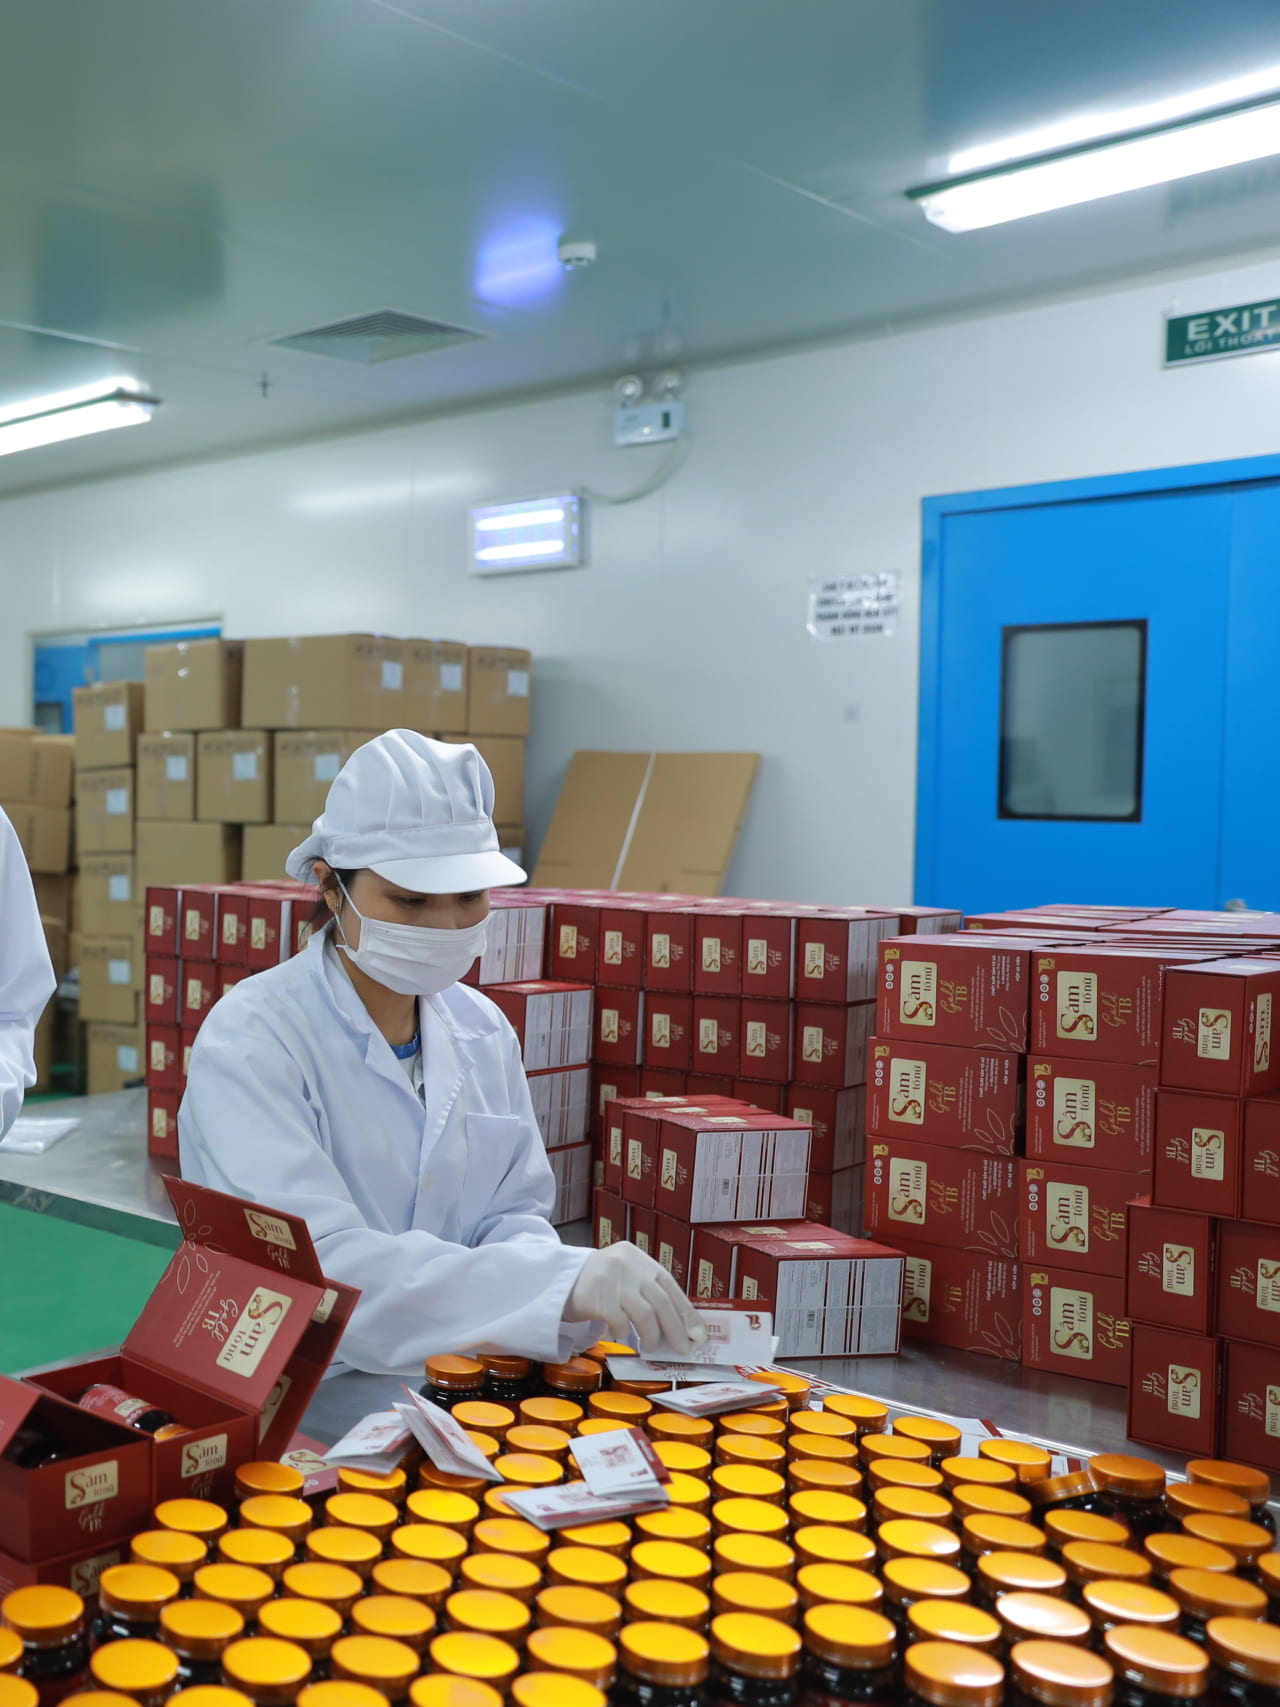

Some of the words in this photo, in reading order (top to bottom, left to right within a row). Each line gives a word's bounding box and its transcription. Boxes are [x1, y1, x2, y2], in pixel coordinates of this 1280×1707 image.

[1187, 304, 1277, 341] EXIT
[903, 974, 933, 1020] Sâm
[939, 979, 963, 1014] Gold
[955, 985, 968, 1002] TB
[1060, 985, 1094, 1034] Sâm
[1101, 992, 1126, 1027] Gold
[1119, 997, 1133, 1014] TB
[1172, 1027, 1183, 1040] TB
[1179, 1018, 1196, 1045] Gold
[1201, 1011, 1229, 1049] Sâm
[892, 1072, 921, 1119] Sâm
[929, 1080, 950, 1114] Gold
[944, 1086, 956, 1102] TB
[1057, 1092, 1092, 1142] Sâm
[1099, 1100, 1124, 1135] Gold
[1117, 1106, 1131, 1123] TB
[1166, 1146, 1176, 1159] TB
[1194, 1132, 1222, 1169] Sâm
[891, 1172, 923, 1219] Sâm
[929, 1179, 952, 1214] Gold
[946, 1187, 959, 1203] TB
[1050, 1197, 1086, 1248] Sâm
[1092, 1204, 1119, 1241] Gold
[1111, 1212, 1125, 1229] TB
[1138, 1259, 1149, 1272] TB
[1165, 1247, 1192, 1285] Sâm
[1230, 1274, 1242, 1288] TB
[1053, 1302, 1090, 1354] Sâm
[1097, 1312, 1124, 1349] Gold
[1115, 1320, 1130, 1337] TB
[1142, 1379, 1153, 1393] TB
[1170, 1368, 1198, 1408] Sâm
